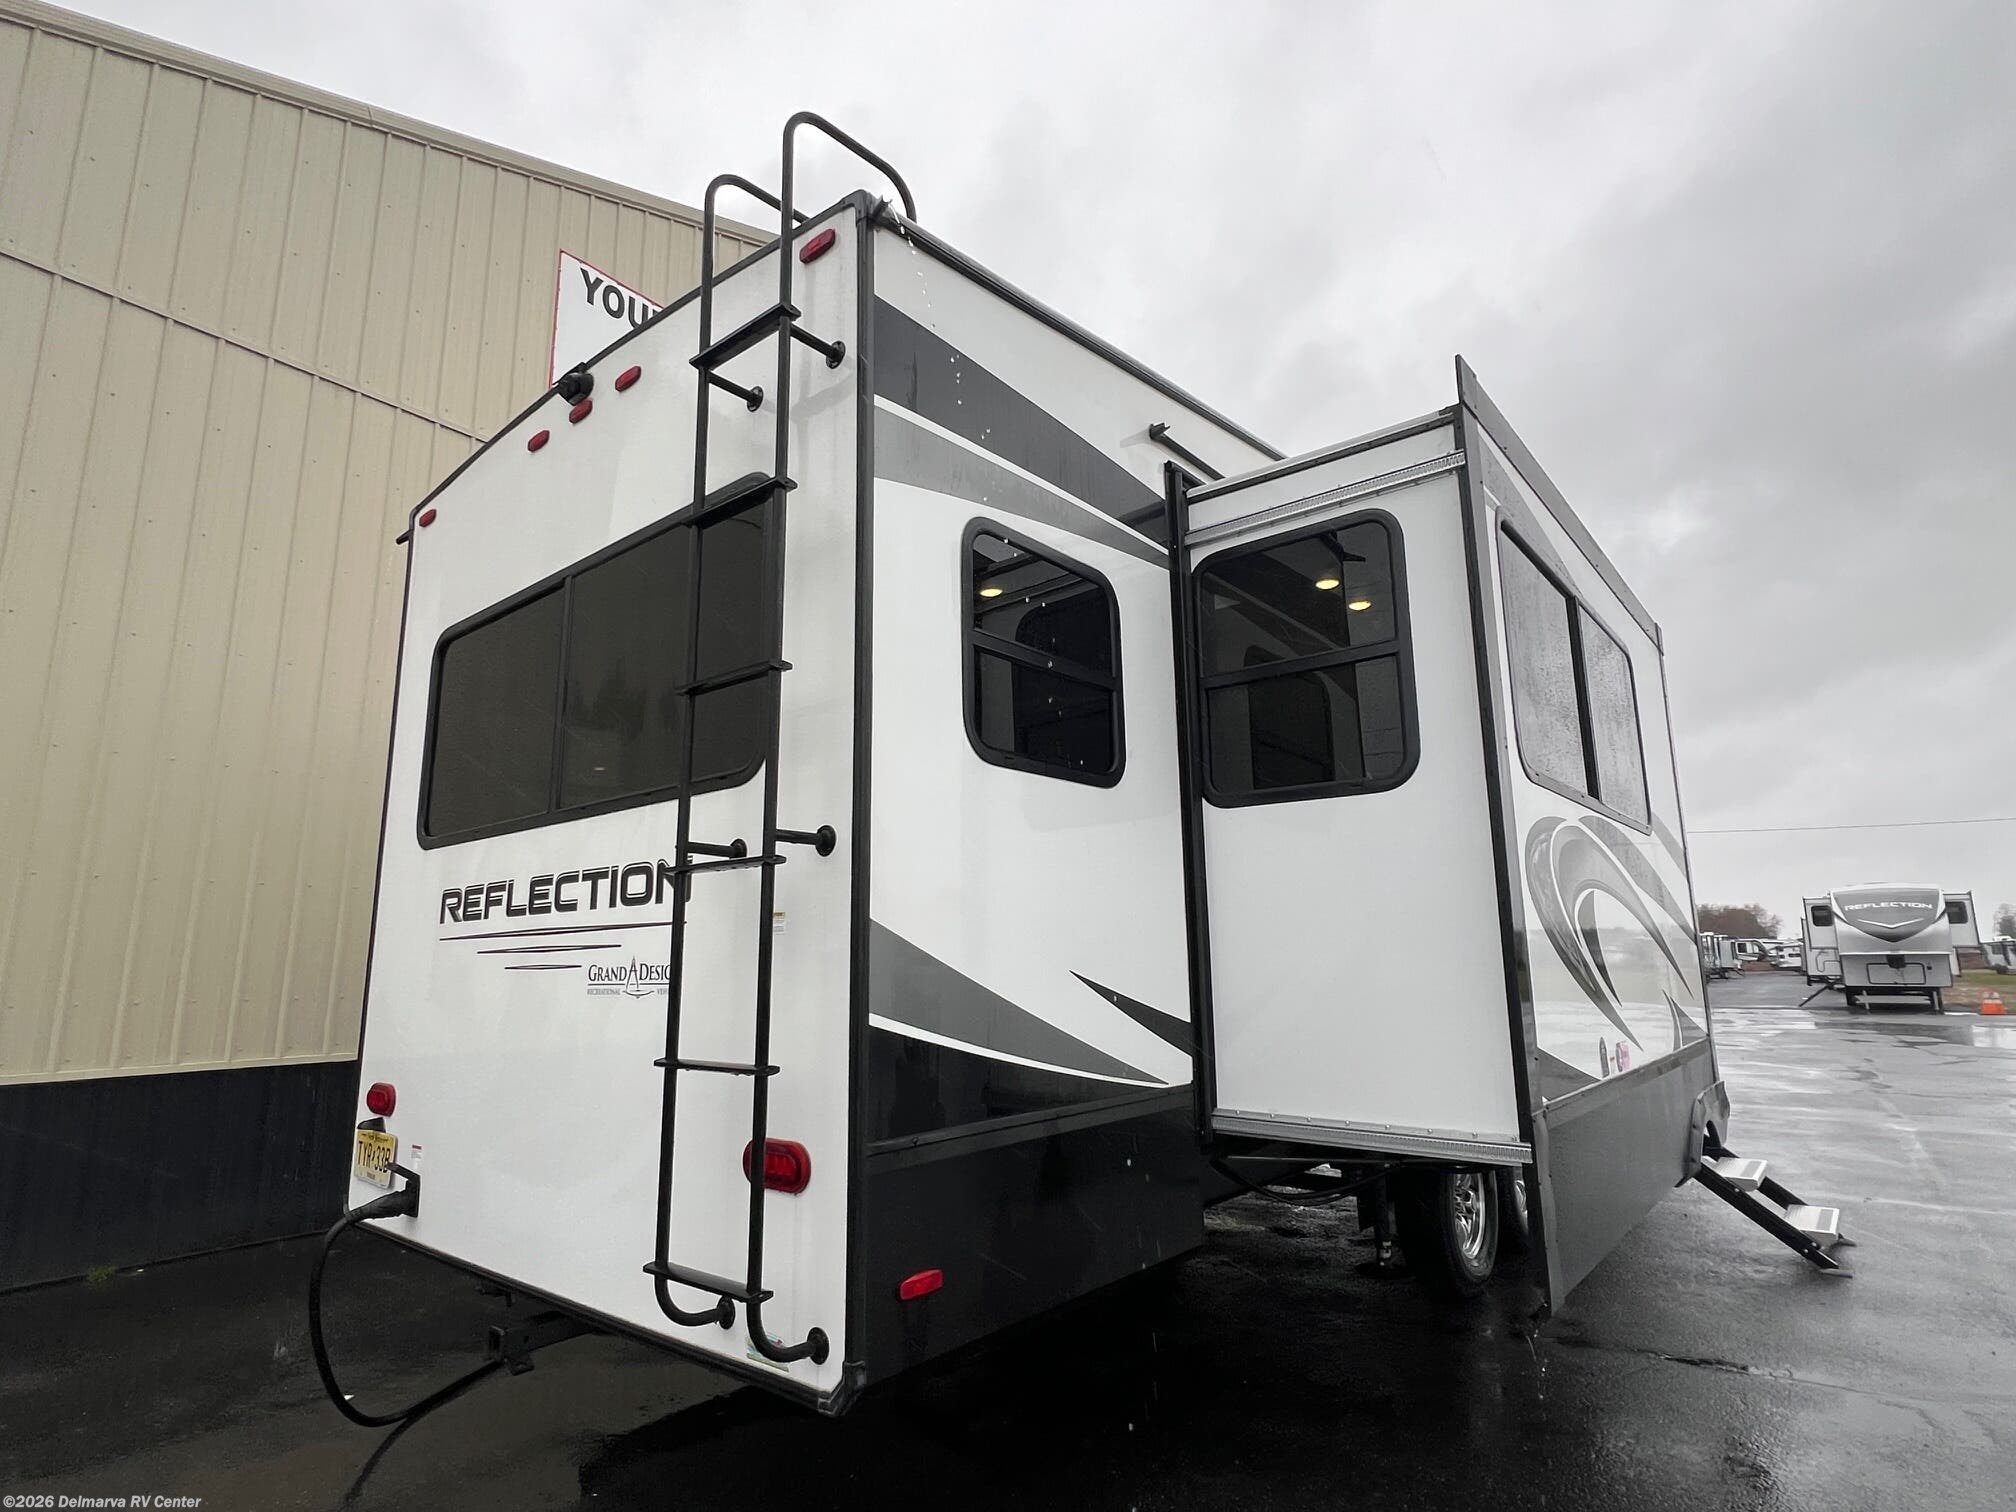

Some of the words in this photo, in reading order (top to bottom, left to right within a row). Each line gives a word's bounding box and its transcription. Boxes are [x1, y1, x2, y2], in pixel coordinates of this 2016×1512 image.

[580, 267, 661, 330] YOU
[439, 855, 693, 924] REFLECTION
[1844, 902, 1933, 911] REFLECTION
[588, 964, 627, 982] GRAND
